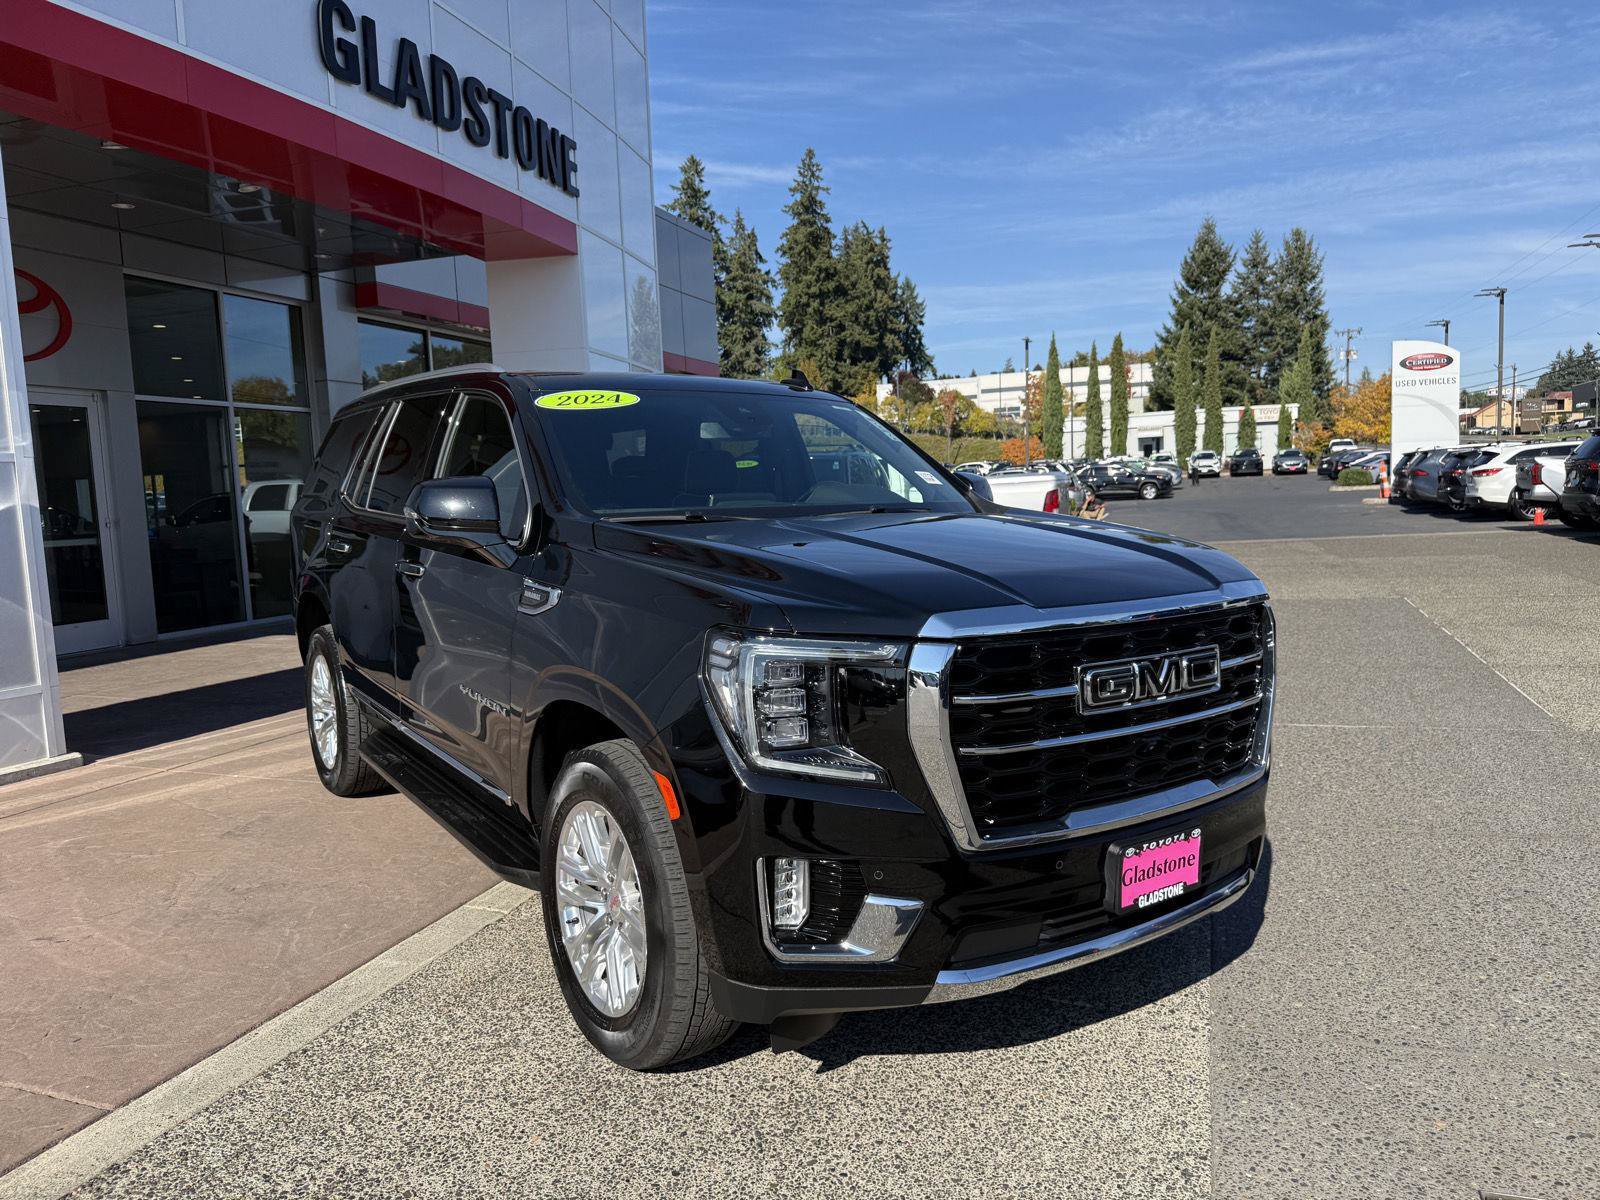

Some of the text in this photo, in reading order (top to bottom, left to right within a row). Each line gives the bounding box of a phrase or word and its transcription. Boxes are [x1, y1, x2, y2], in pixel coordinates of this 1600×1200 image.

[317, 0, 580, 198] GLADSTONE
[1406, 358, 1447, 367] CERTIFIED
[1395, 376, 1457, 388] USED VEHICLES
[556, 393, 623, 407] 2024
[1083, 652, 1219, 707] GMC
[459, 684, 507, 716] YUKON
[1142, 832, 1186, 852] TOYOTA
[1121, 853, 1196, 887] Gladstone
[1138, 881, 1184, 909] GLADSTONE
